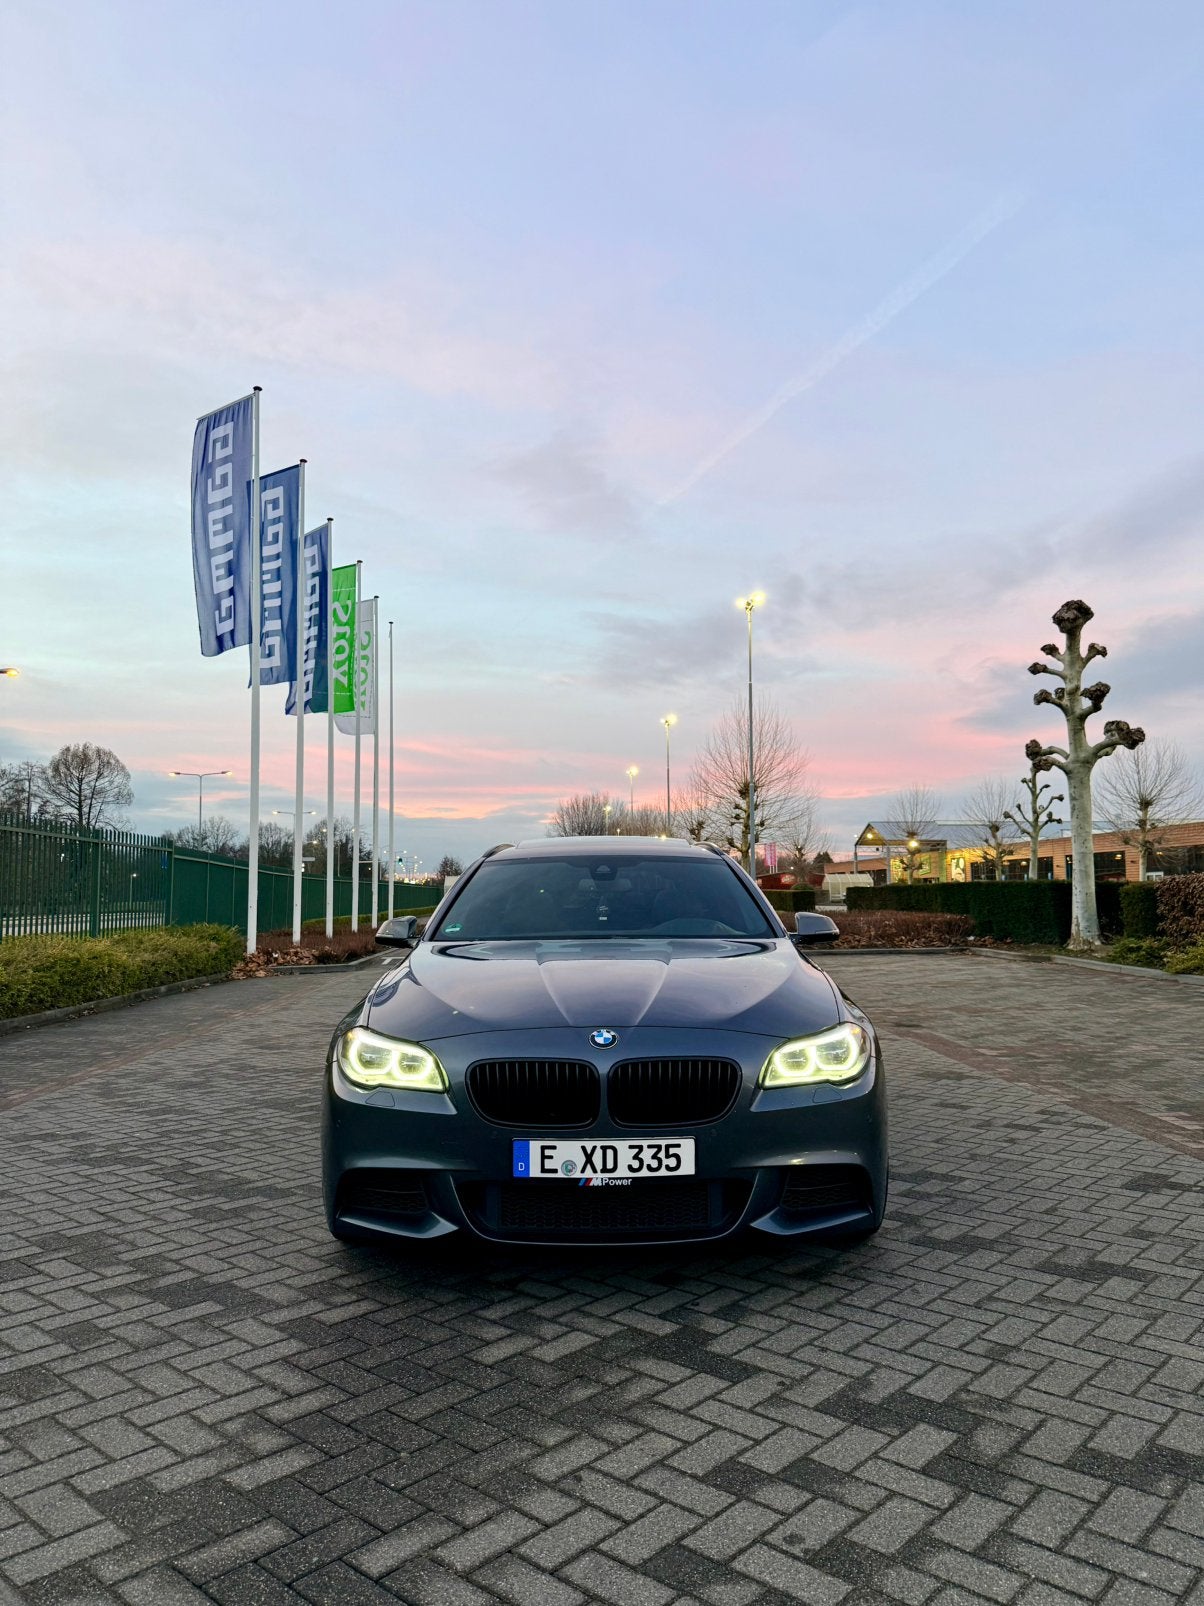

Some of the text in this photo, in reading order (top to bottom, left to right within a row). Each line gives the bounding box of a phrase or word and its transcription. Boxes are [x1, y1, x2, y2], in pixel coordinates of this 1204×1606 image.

[518, 1162, 525, 1171] D
[540, 1143, 682, 1174] E XD 335
